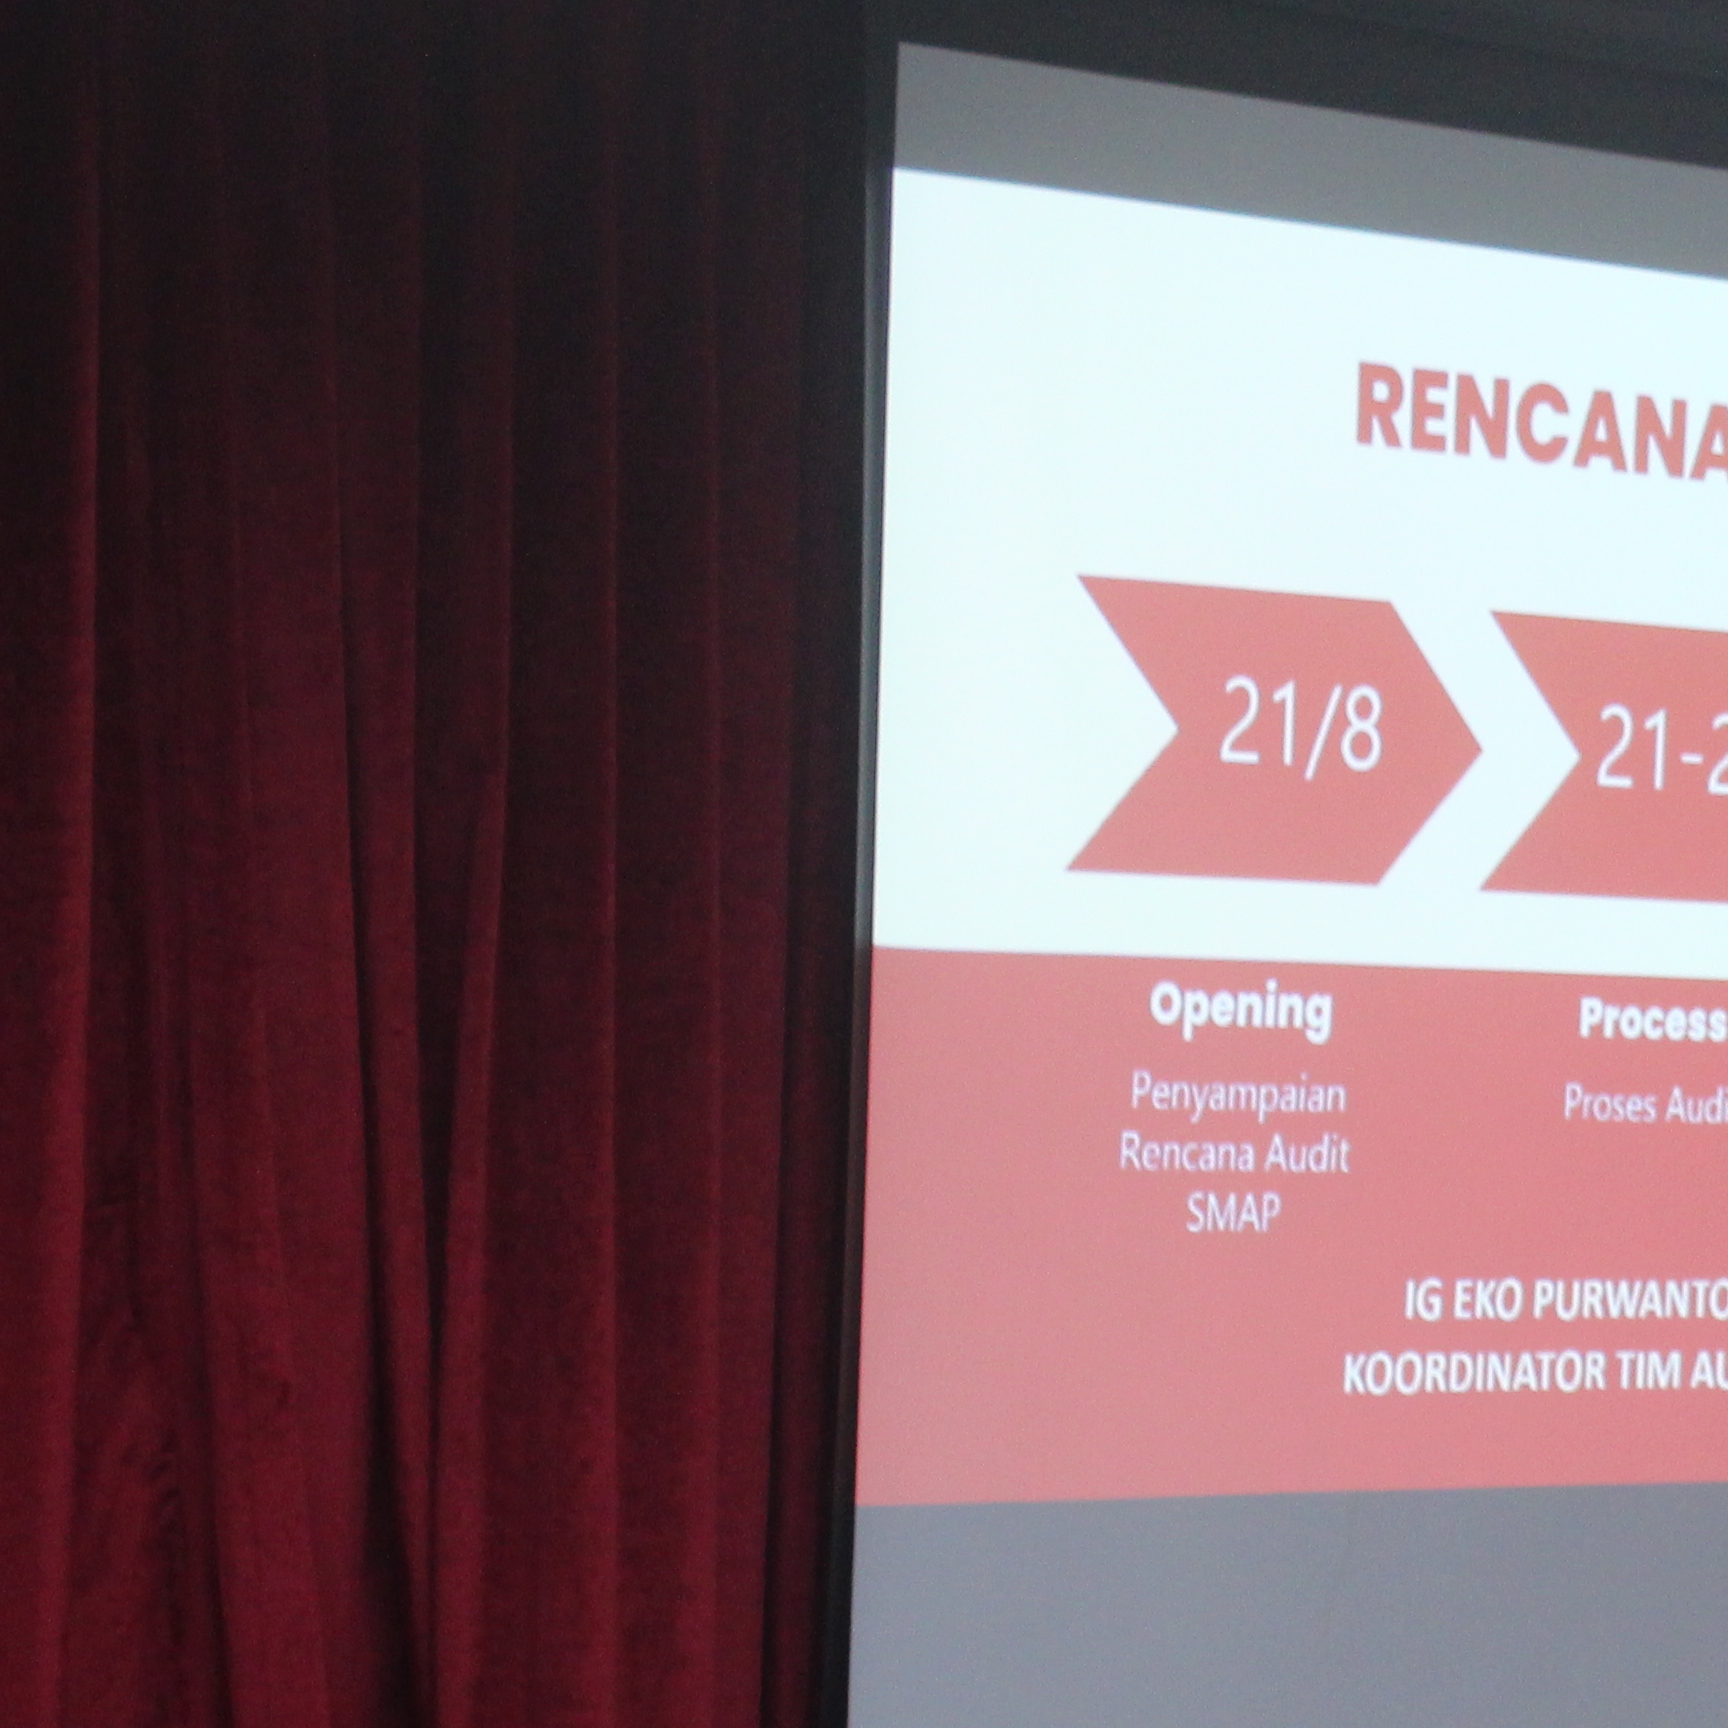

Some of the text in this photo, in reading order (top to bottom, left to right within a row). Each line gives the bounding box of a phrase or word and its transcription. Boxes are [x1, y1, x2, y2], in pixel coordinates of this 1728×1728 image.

[1220, 675, 1382, 780] 21/8
[1150, 979, 1332, 1044] Opening
[1580, 997, 1728, 1042] Process
[1132, 1069, 1346, 1123] Penyampaian
[1564, 1082, 1657, 1123] Proses
[1121, 1130, 1350, 1173] Rencana Audit
[1187, 1191, 1281, 1232] SMAP
[1405, 1277, 1442, 1321] IG
[1454, 1278, 1523, 1321] EKO
[1344, 1350, 1606, 1395] KOORDINATOR
[1616, 1351, 1682, 1389] TIM
